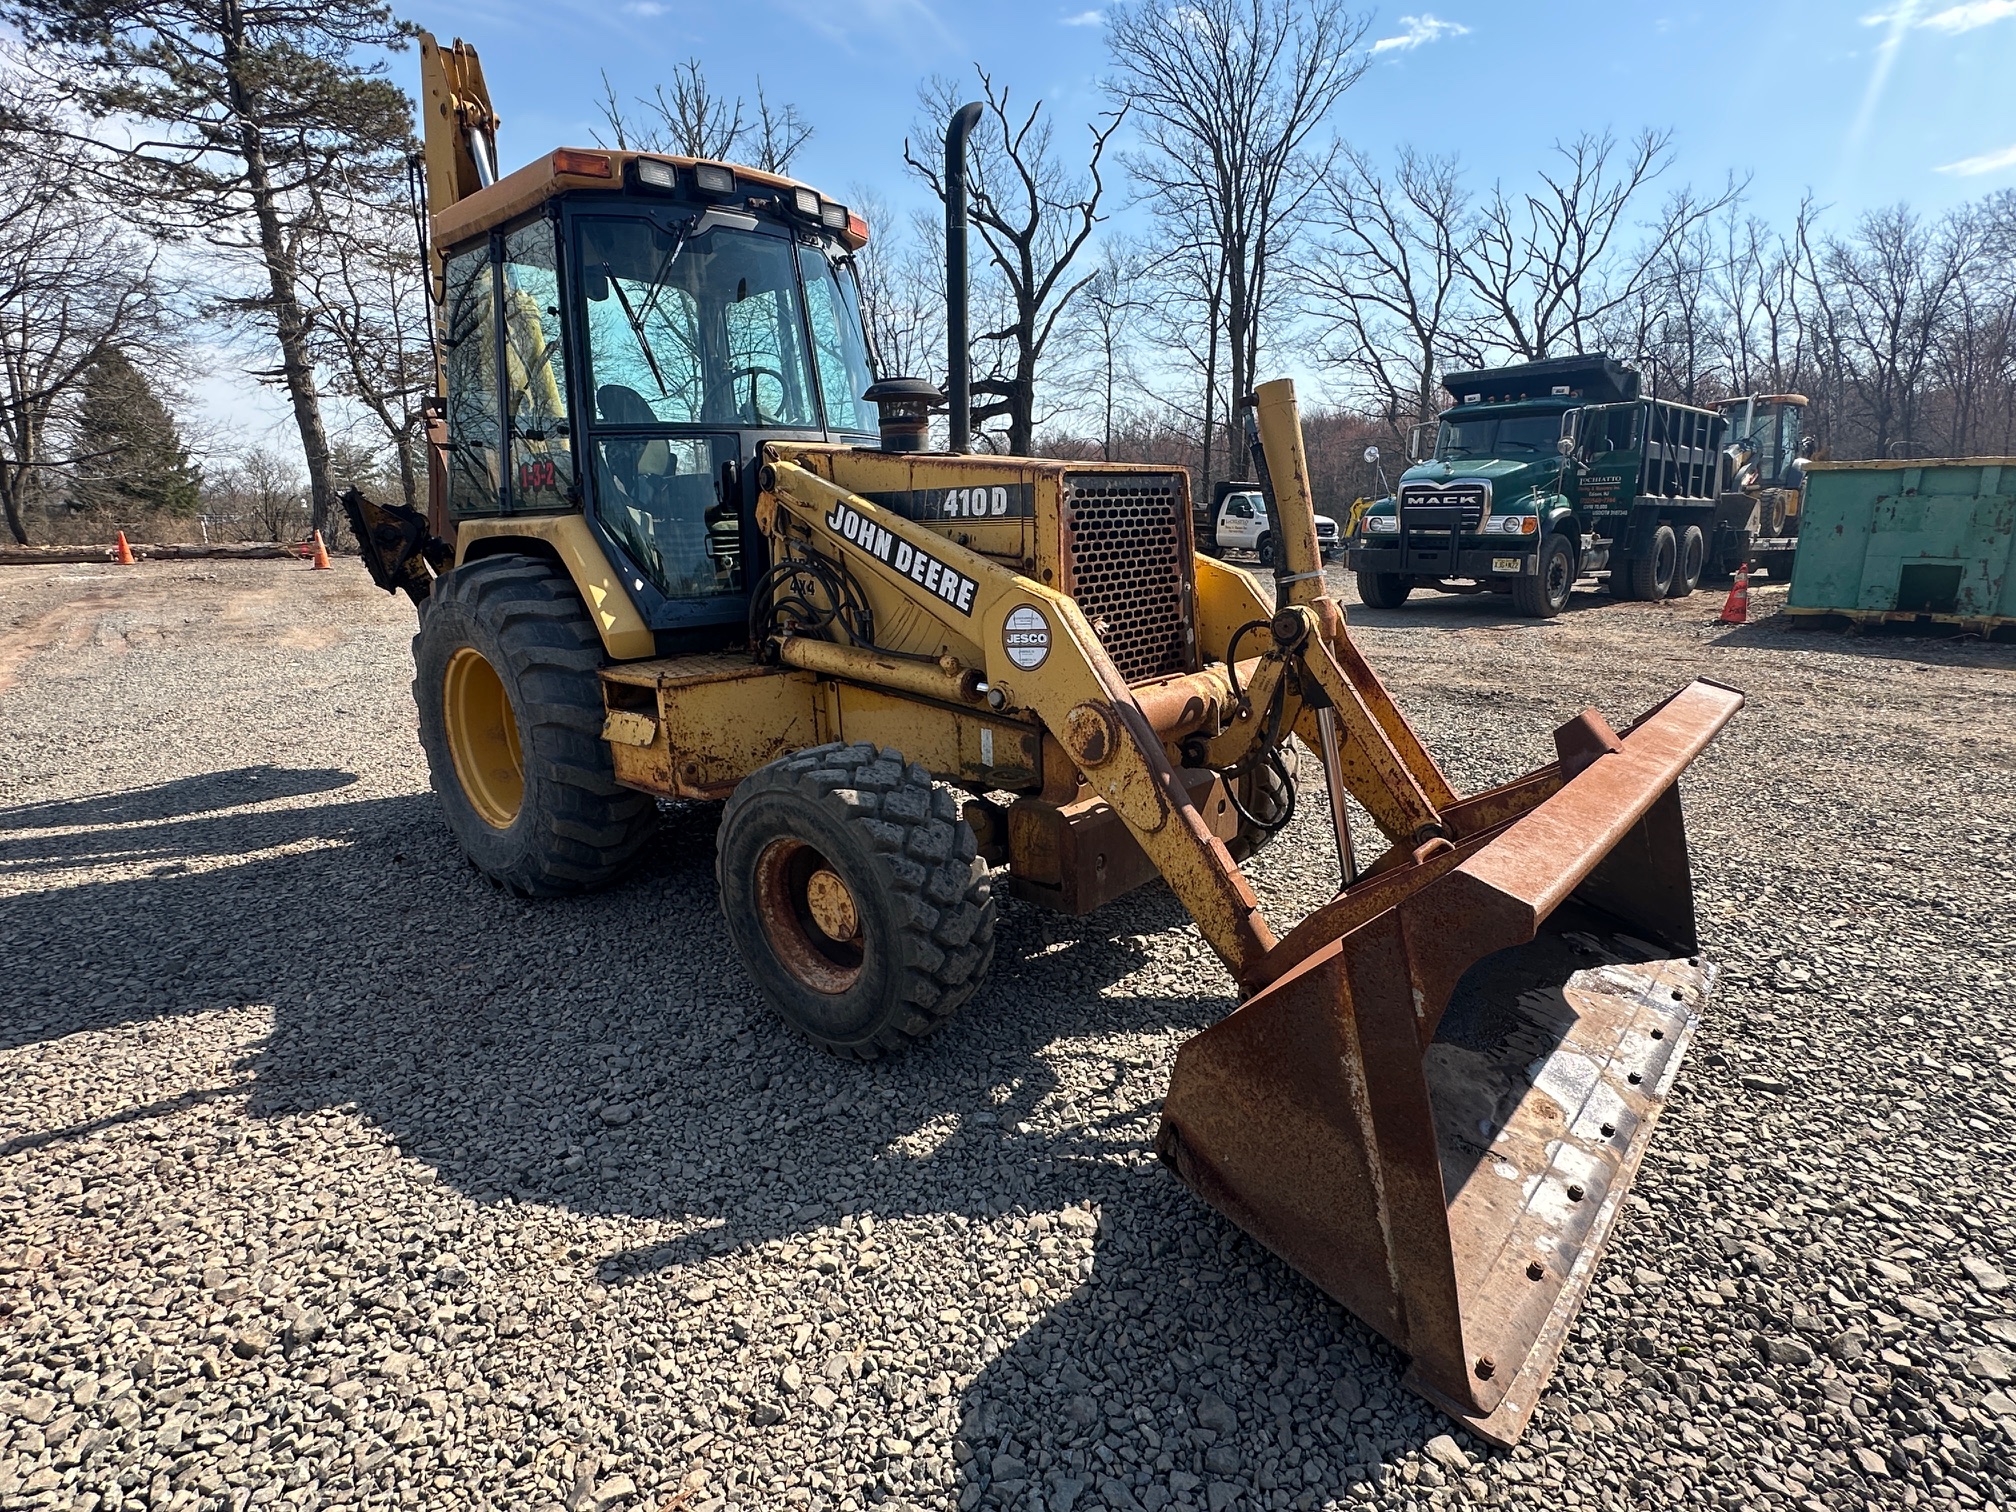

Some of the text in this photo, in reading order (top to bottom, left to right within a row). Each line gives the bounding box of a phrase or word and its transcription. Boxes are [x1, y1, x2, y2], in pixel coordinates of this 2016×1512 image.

[521, 462, 554, 488] 1-3-2
[1407, 496, 1476, 505] MACK
[828, 503, 976, 612] JOHN DEERE
[1006, 633, 1047, 644] JESCO
